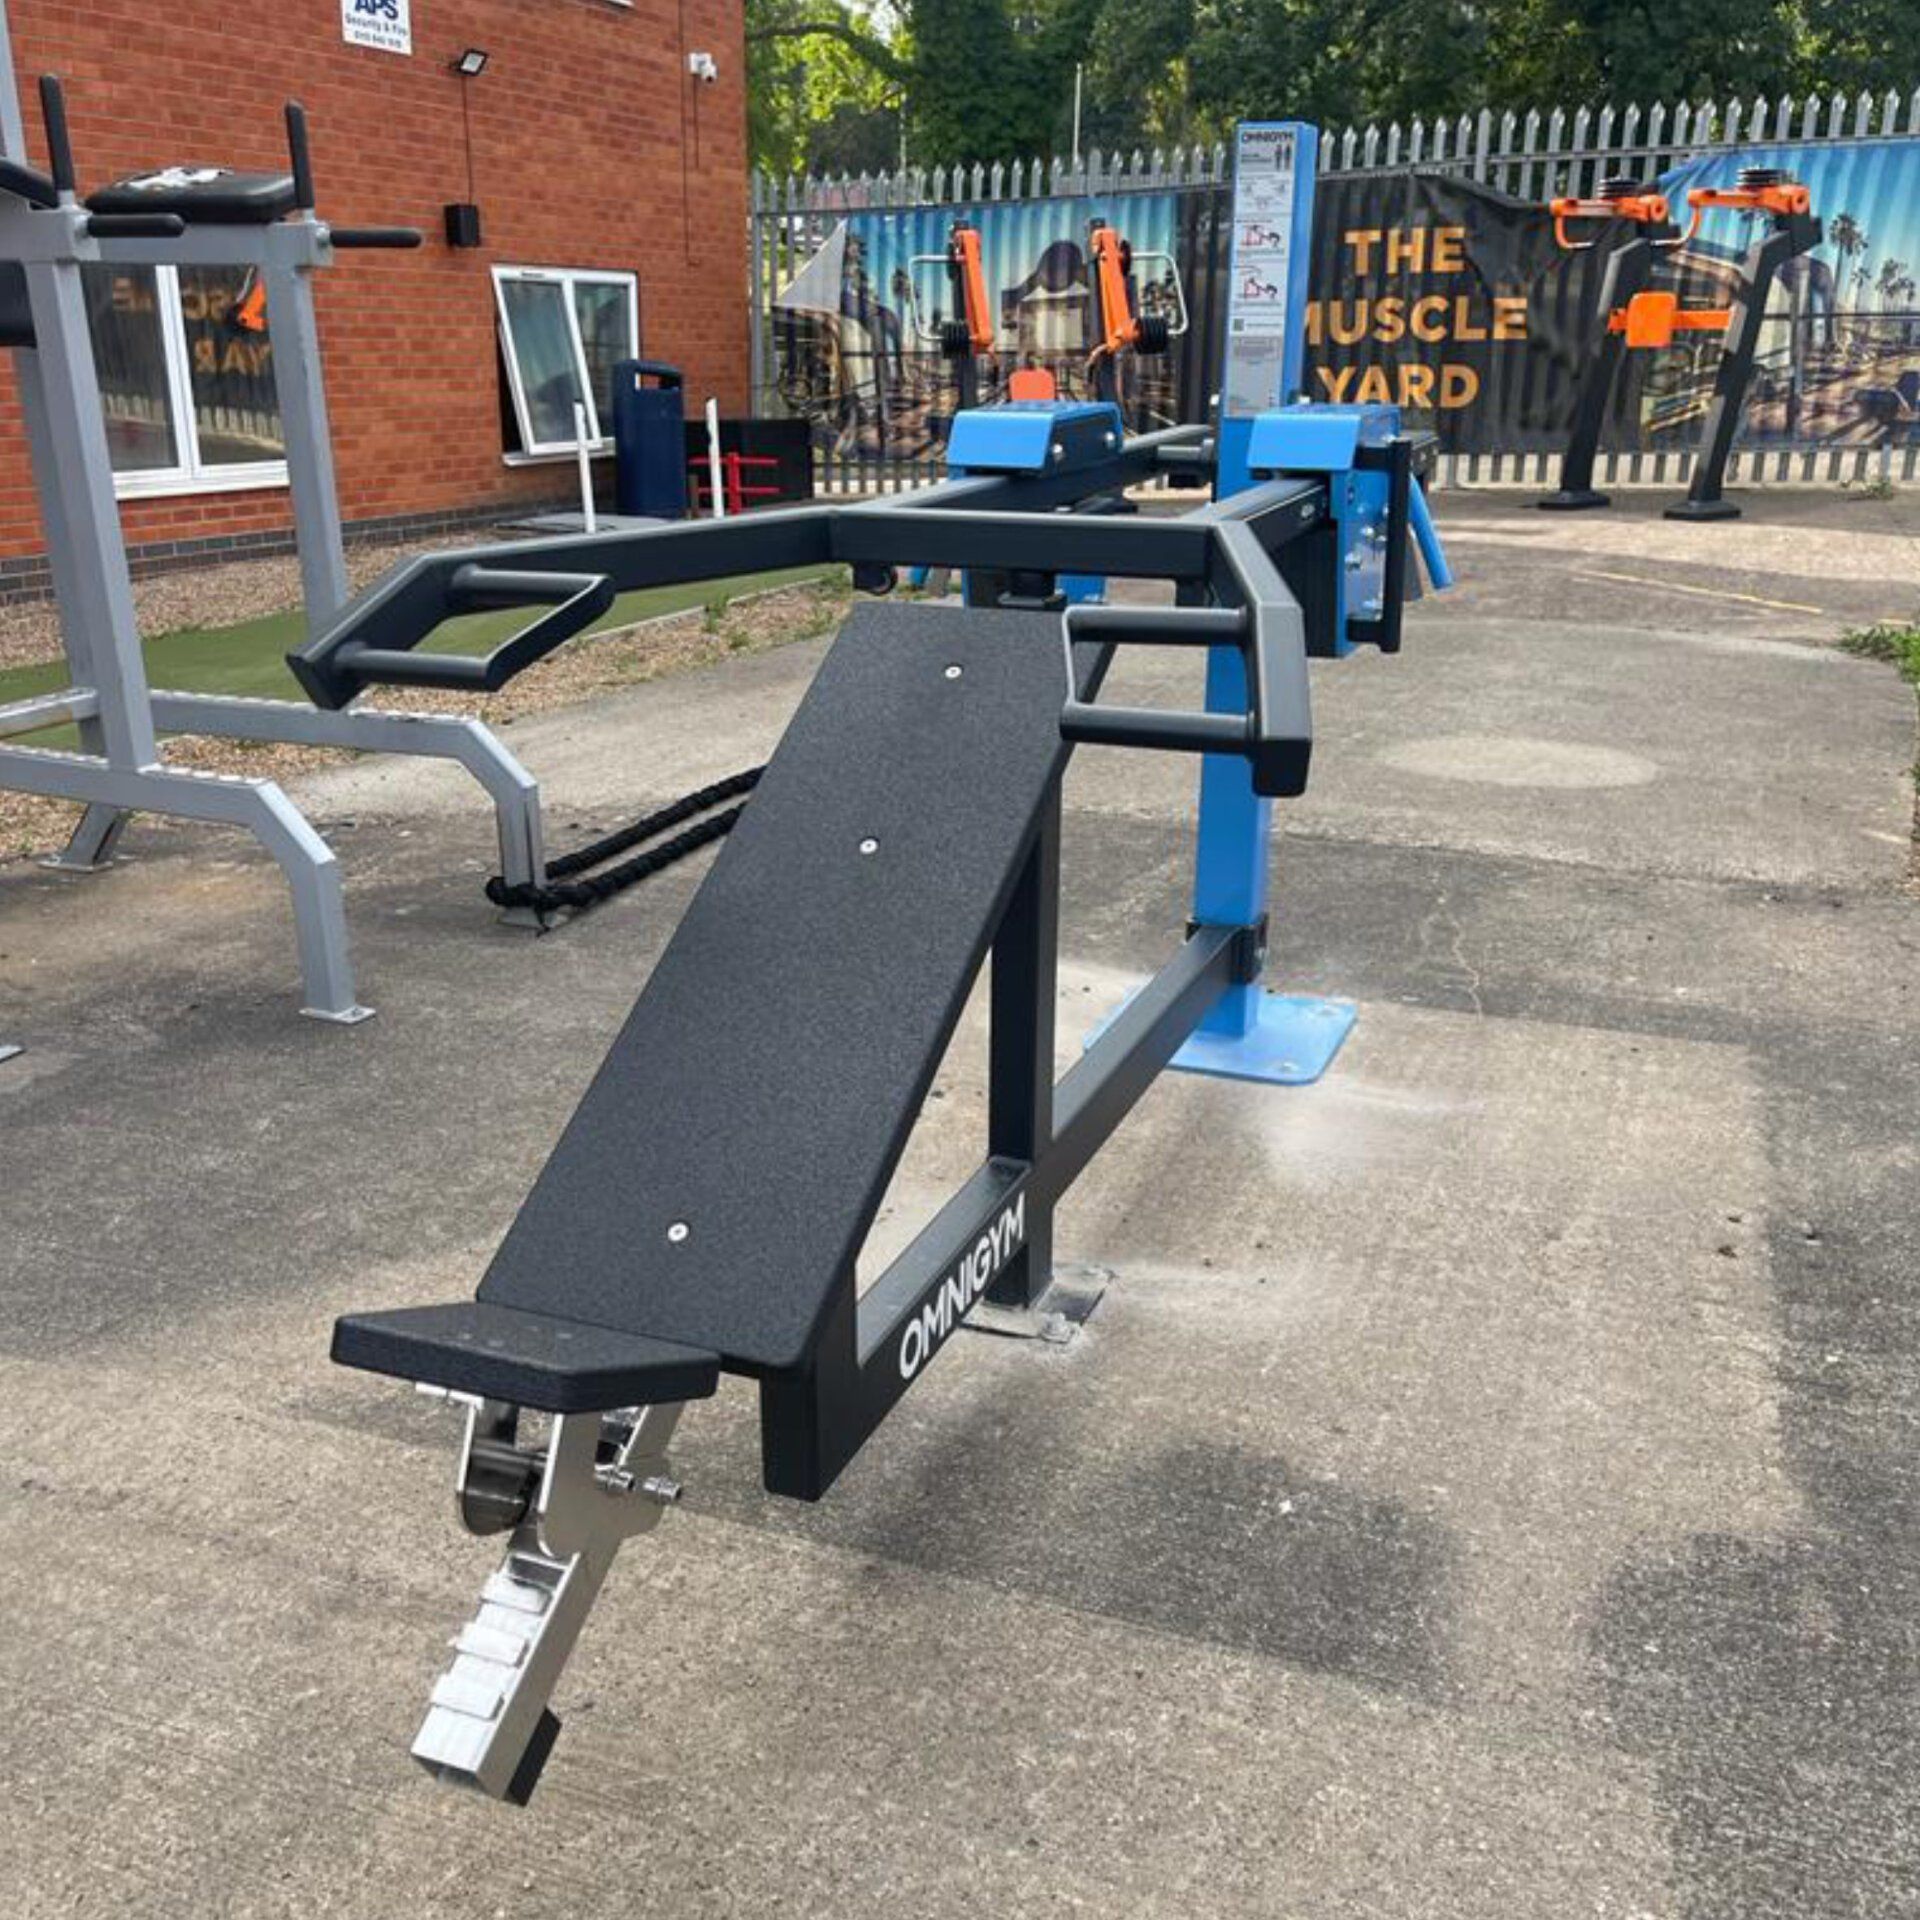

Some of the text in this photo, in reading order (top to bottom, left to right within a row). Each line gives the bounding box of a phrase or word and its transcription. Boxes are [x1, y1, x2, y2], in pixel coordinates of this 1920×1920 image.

[1345, 226, 1466, 275] THE
[1316, 363, 1480, 409] YARD
[900, 1191, 1025, 1380] OMNIGYM
